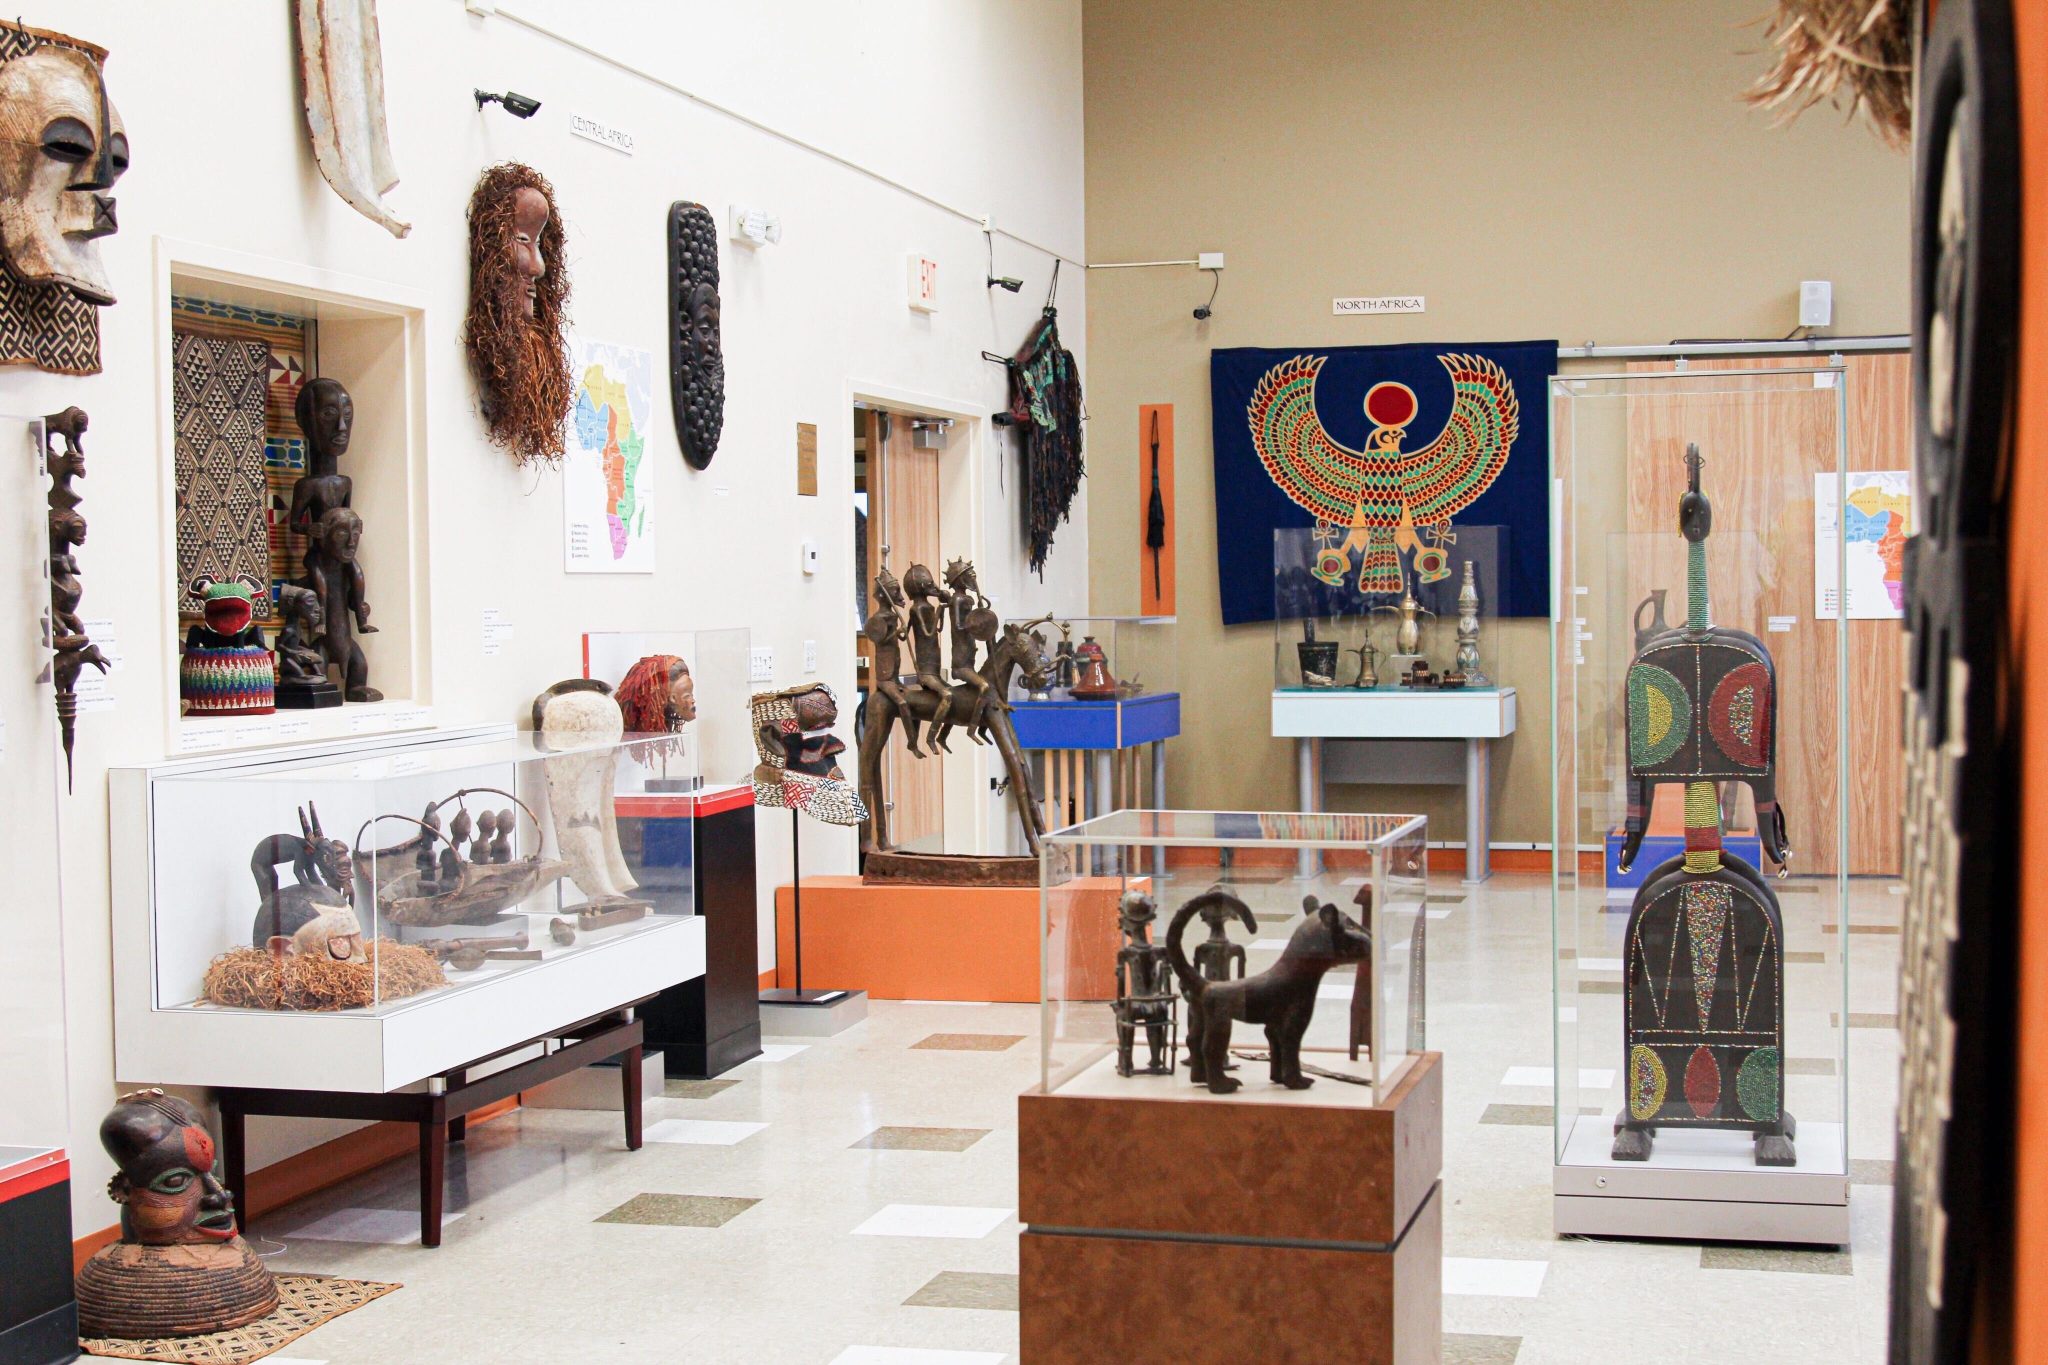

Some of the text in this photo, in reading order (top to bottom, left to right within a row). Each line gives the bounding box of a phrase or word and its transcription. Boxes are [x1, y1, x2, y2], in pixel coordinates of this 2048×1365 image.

[572, 115, 633, 149] CENTRAL AFRICA
[1336, 299, 1420, 310] NORTH AFRICA
